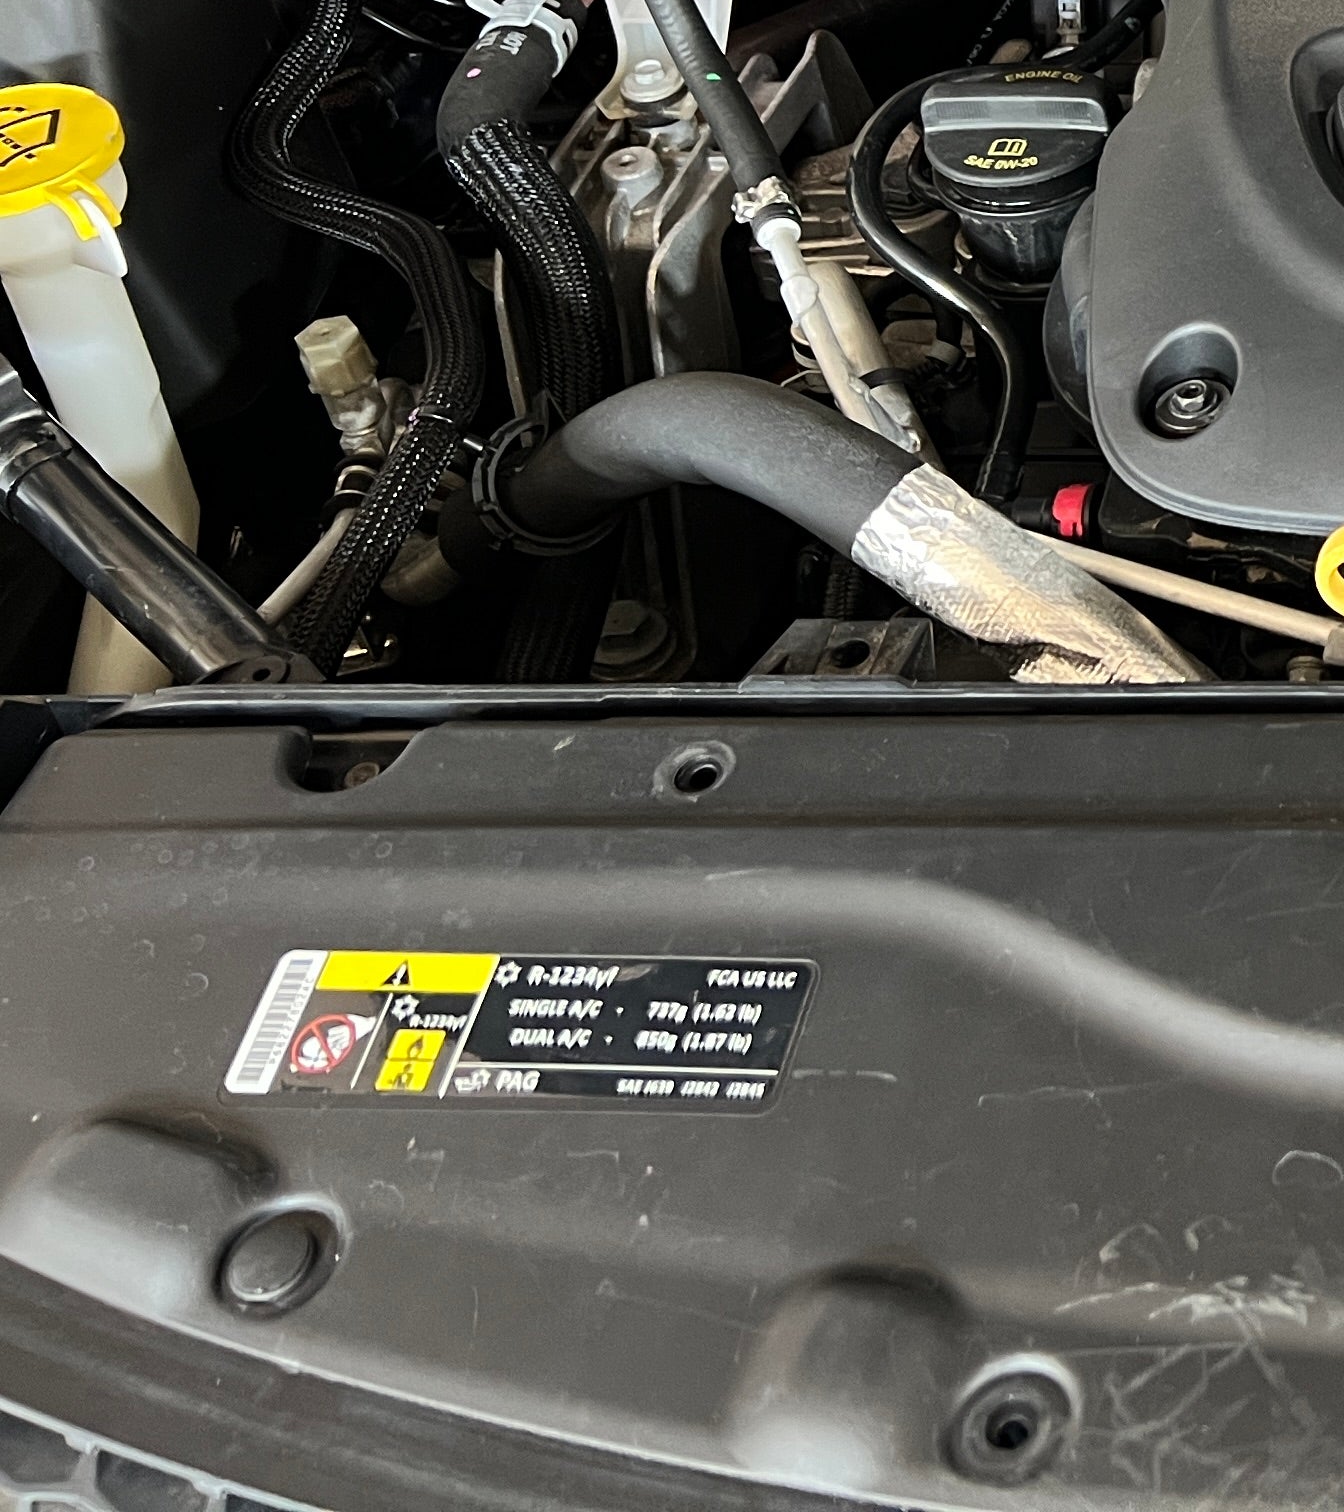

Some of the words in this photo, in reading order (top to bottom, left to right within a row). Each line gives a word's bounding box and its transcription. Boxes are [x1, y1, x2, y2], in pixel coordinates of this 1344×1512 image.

[1004, 70, 1061, 83] ENGINE
[1062, 72, 1084, 84] OIL
[963, 154, 995, 169] SAE
[526, 965, 620, 991] R-1234yf
[706, 968, 741, 988] FCA
[742, 969, 766, 988] US
[767, 971, 798, 990] LLC
[508, 998, 568, 1018] SINGLE
[569, 999, 604, 1020] A/C
[508, 1027, 555, 1047] DUAL
[556, 1028, 593, 1050] A/C
[495, 1070, 541, 1094] PAG
